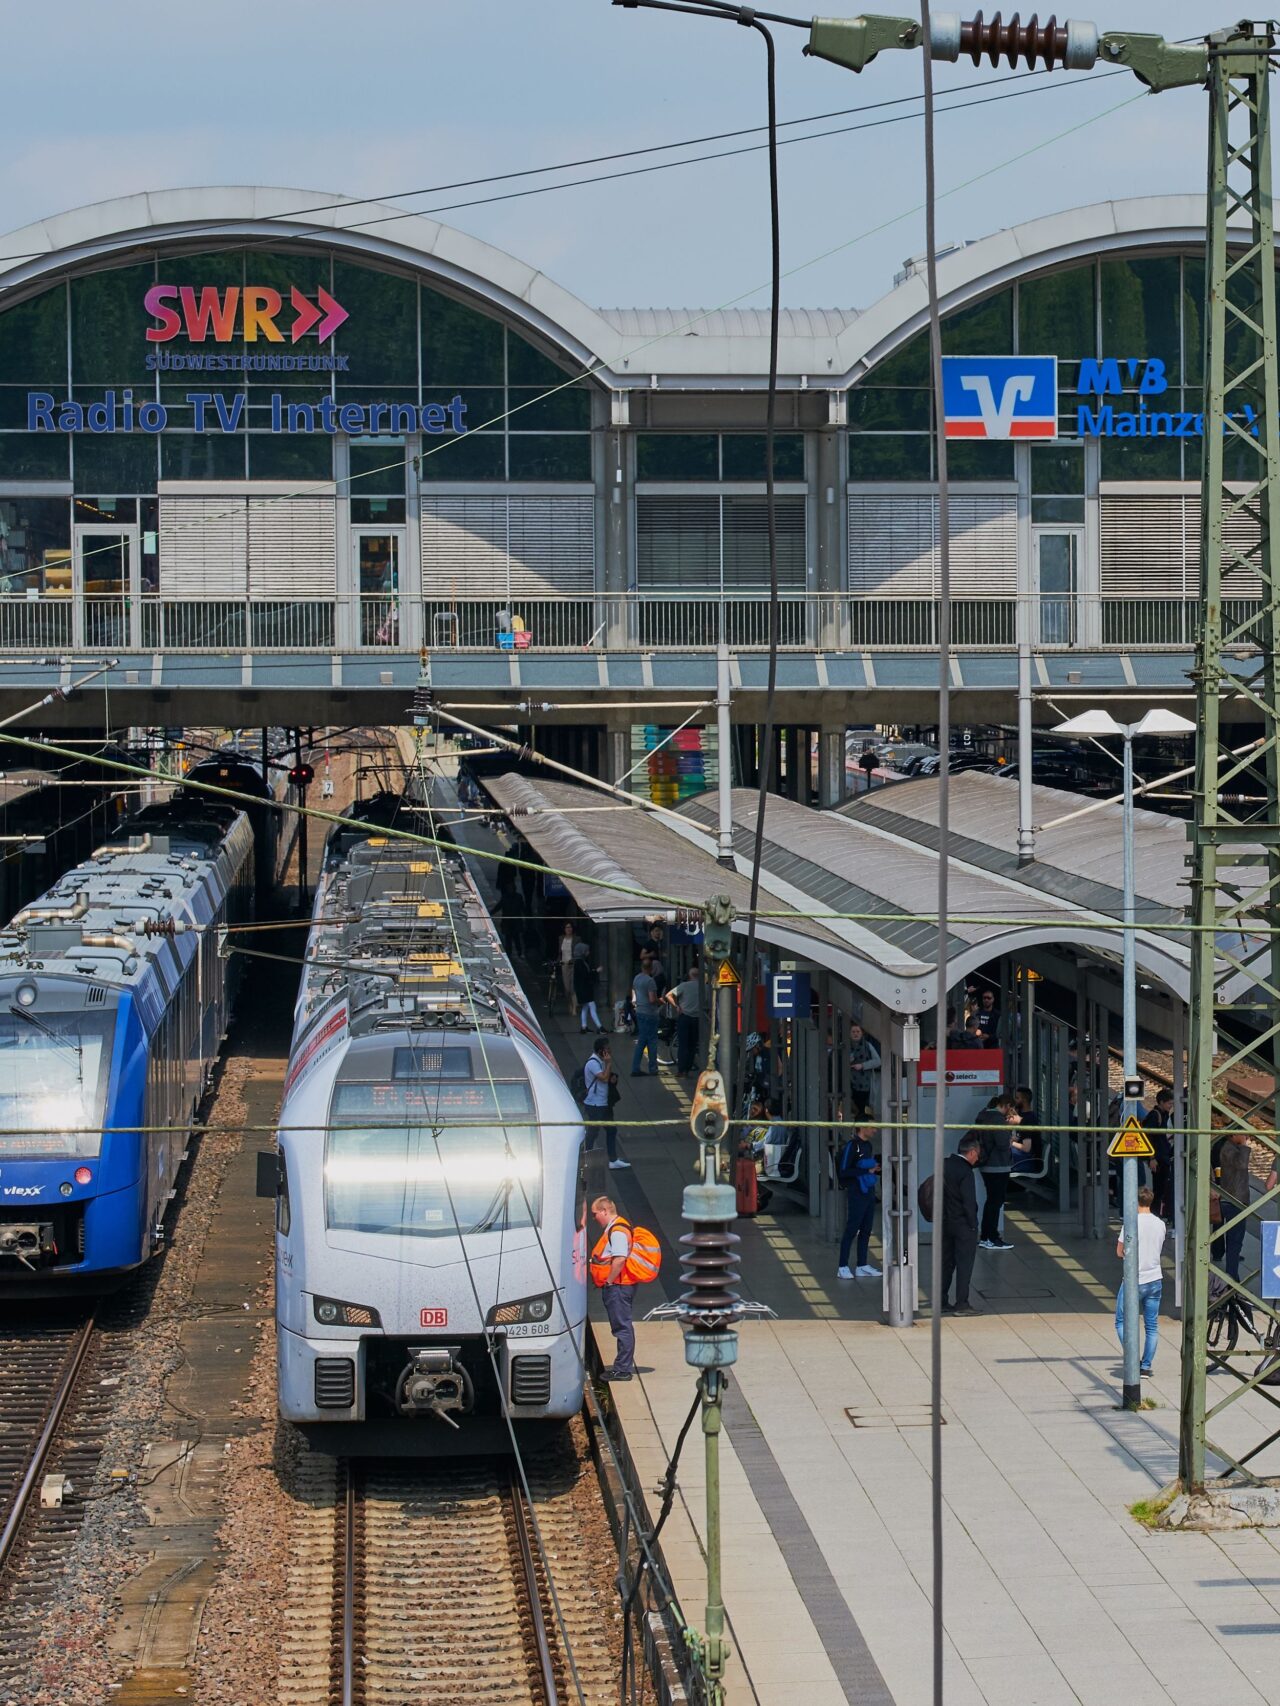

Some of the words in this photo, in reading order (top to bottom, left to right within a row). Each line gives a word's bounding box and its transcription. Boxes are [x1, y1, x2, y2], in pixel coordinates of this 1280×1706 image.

[144, 285, 286, 342] SWR
[145, 351, 350, 372] SÜDWESTRUNDFUNK
[27, 389, 168, 433] Radio
[187, 393, 246, 433] TV
[271, 394, 468, 434] Internet
[325, 783, 331, 792] 7
[773, 976, 793, 1007] E
[4, 1185, 46, 1196] vlexx
[423, 1311, 444, 1325] DB
[509, 1326, 529, 1336] 429
[531, 1324, 550, 1335] 608
